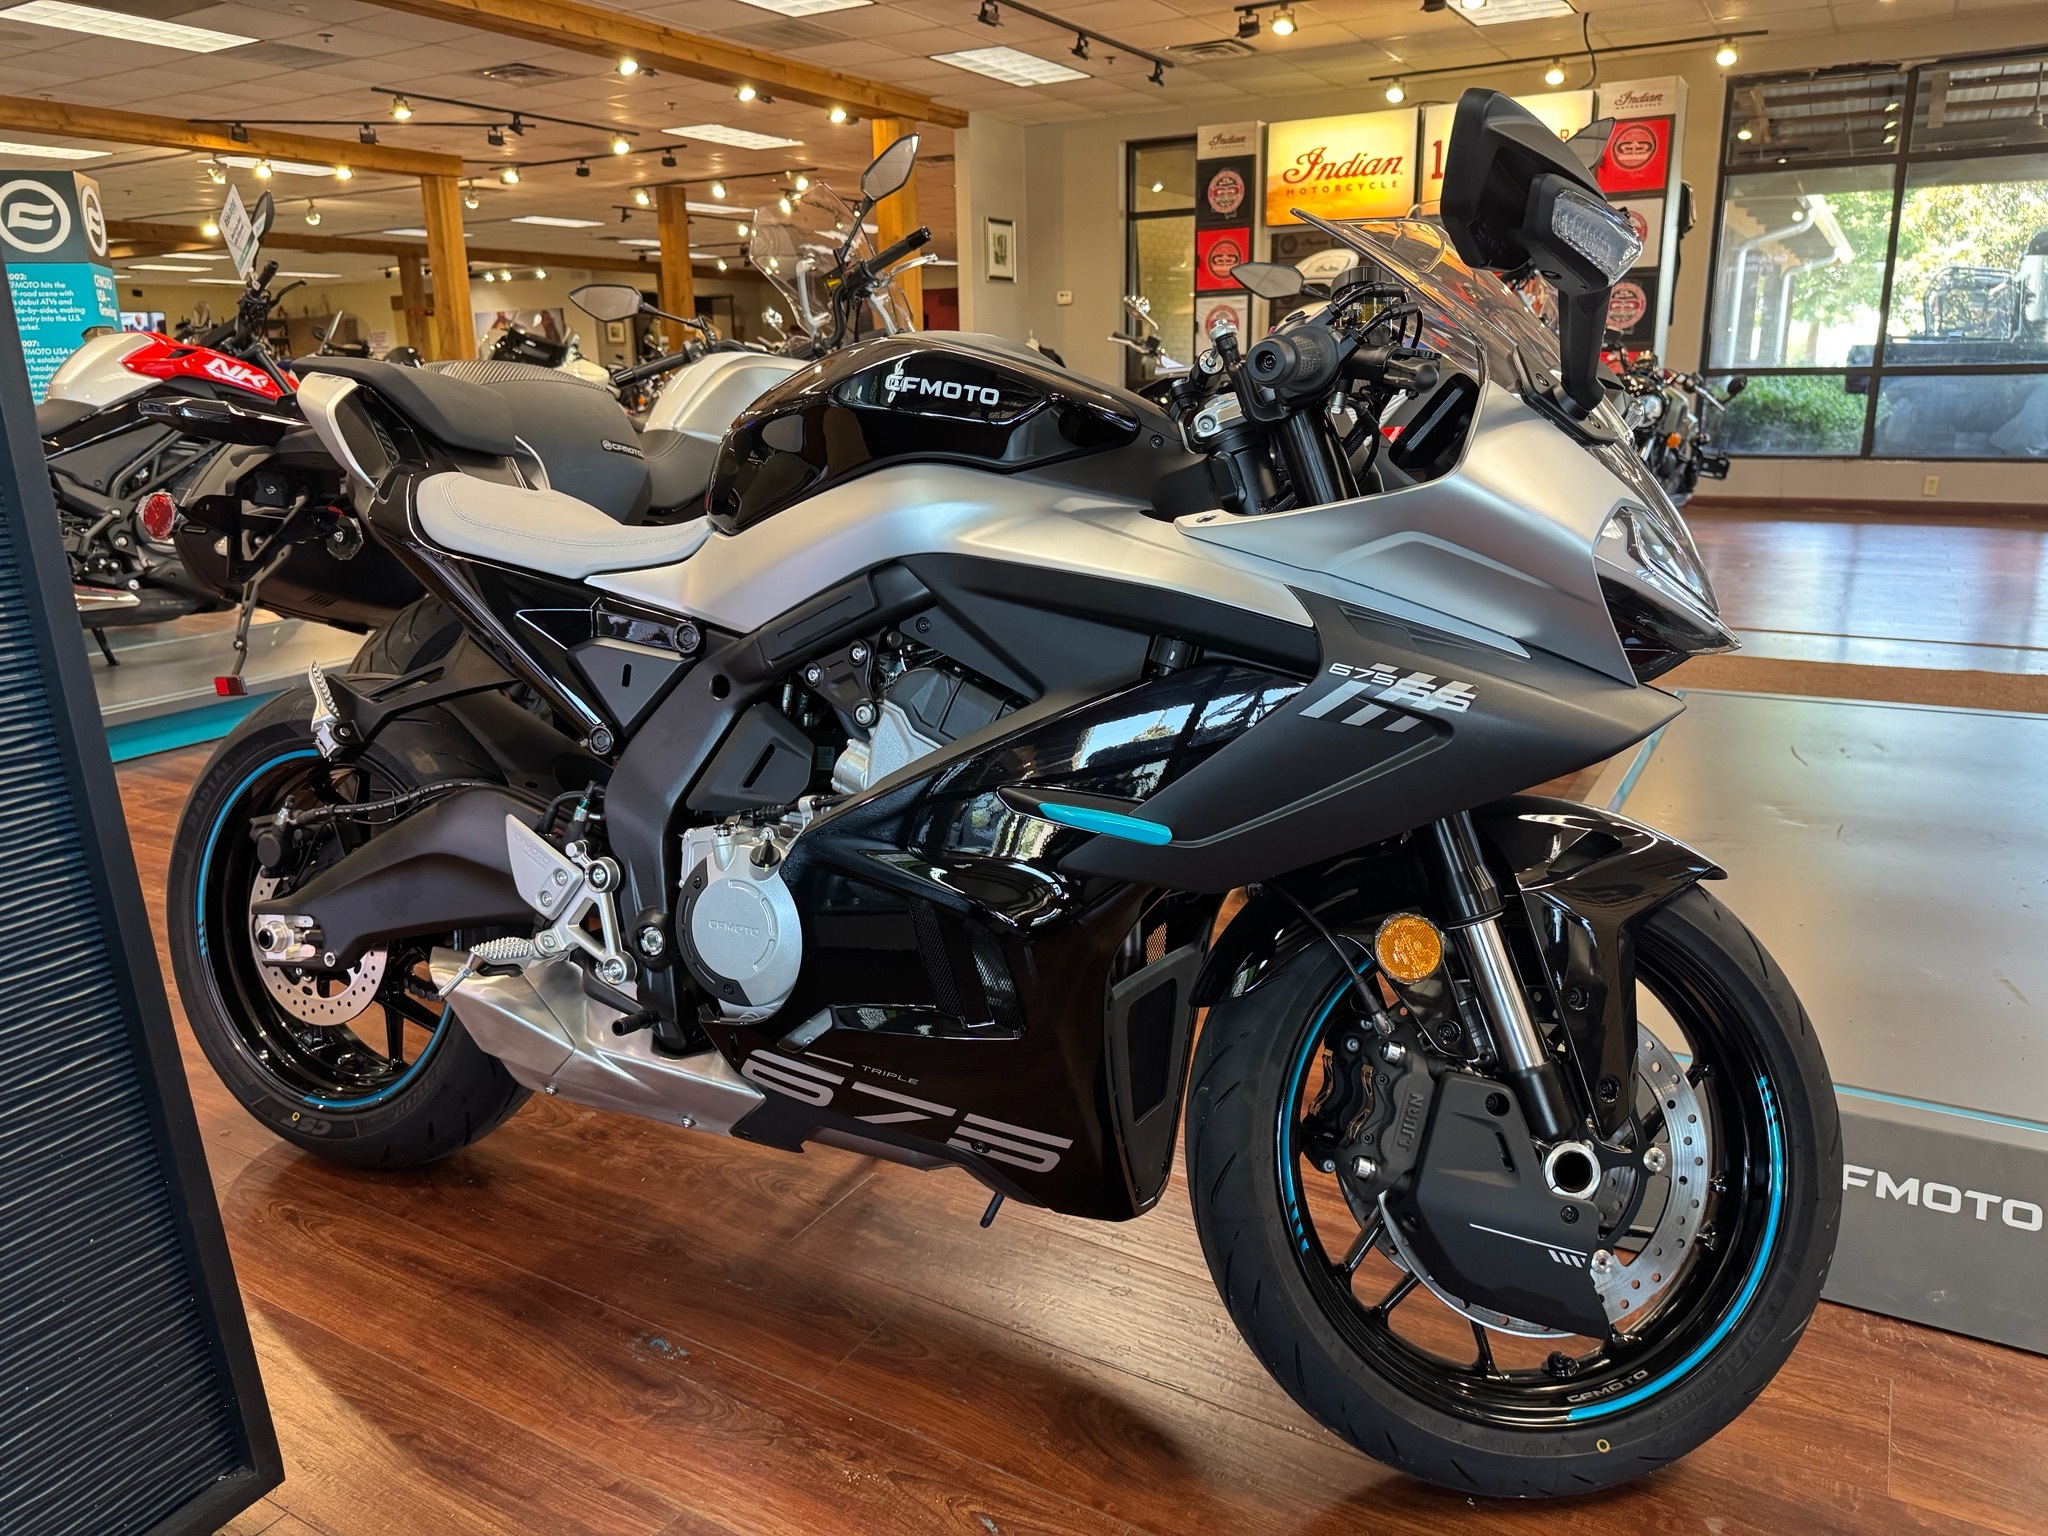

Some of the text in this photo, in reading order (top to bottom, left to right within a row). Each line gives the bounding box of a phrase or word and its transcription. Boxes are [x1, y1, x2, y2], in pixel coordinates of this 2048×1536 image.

[1209, 132, 1246, 146] Indian
[1282, 147, 1403, 185] Indian
[1286, 180, 1398, 197] MOTORCYCLE
[12, 289, 36, 297] ff-road
[59, 306, 85, 315] making
[203, 358, 269, 389] NK
[885, 374, 1000, 406] CFMOTO
[1328, 662, 1398, 687] 675
[861, 1065, 920, 1086] TRIPLE
[741, 1049, 1074, 1173] 675
[1842, 1164, 2043, 1232] FMOTO
[1566, 1369, 1649, 1403] CFMOTO
